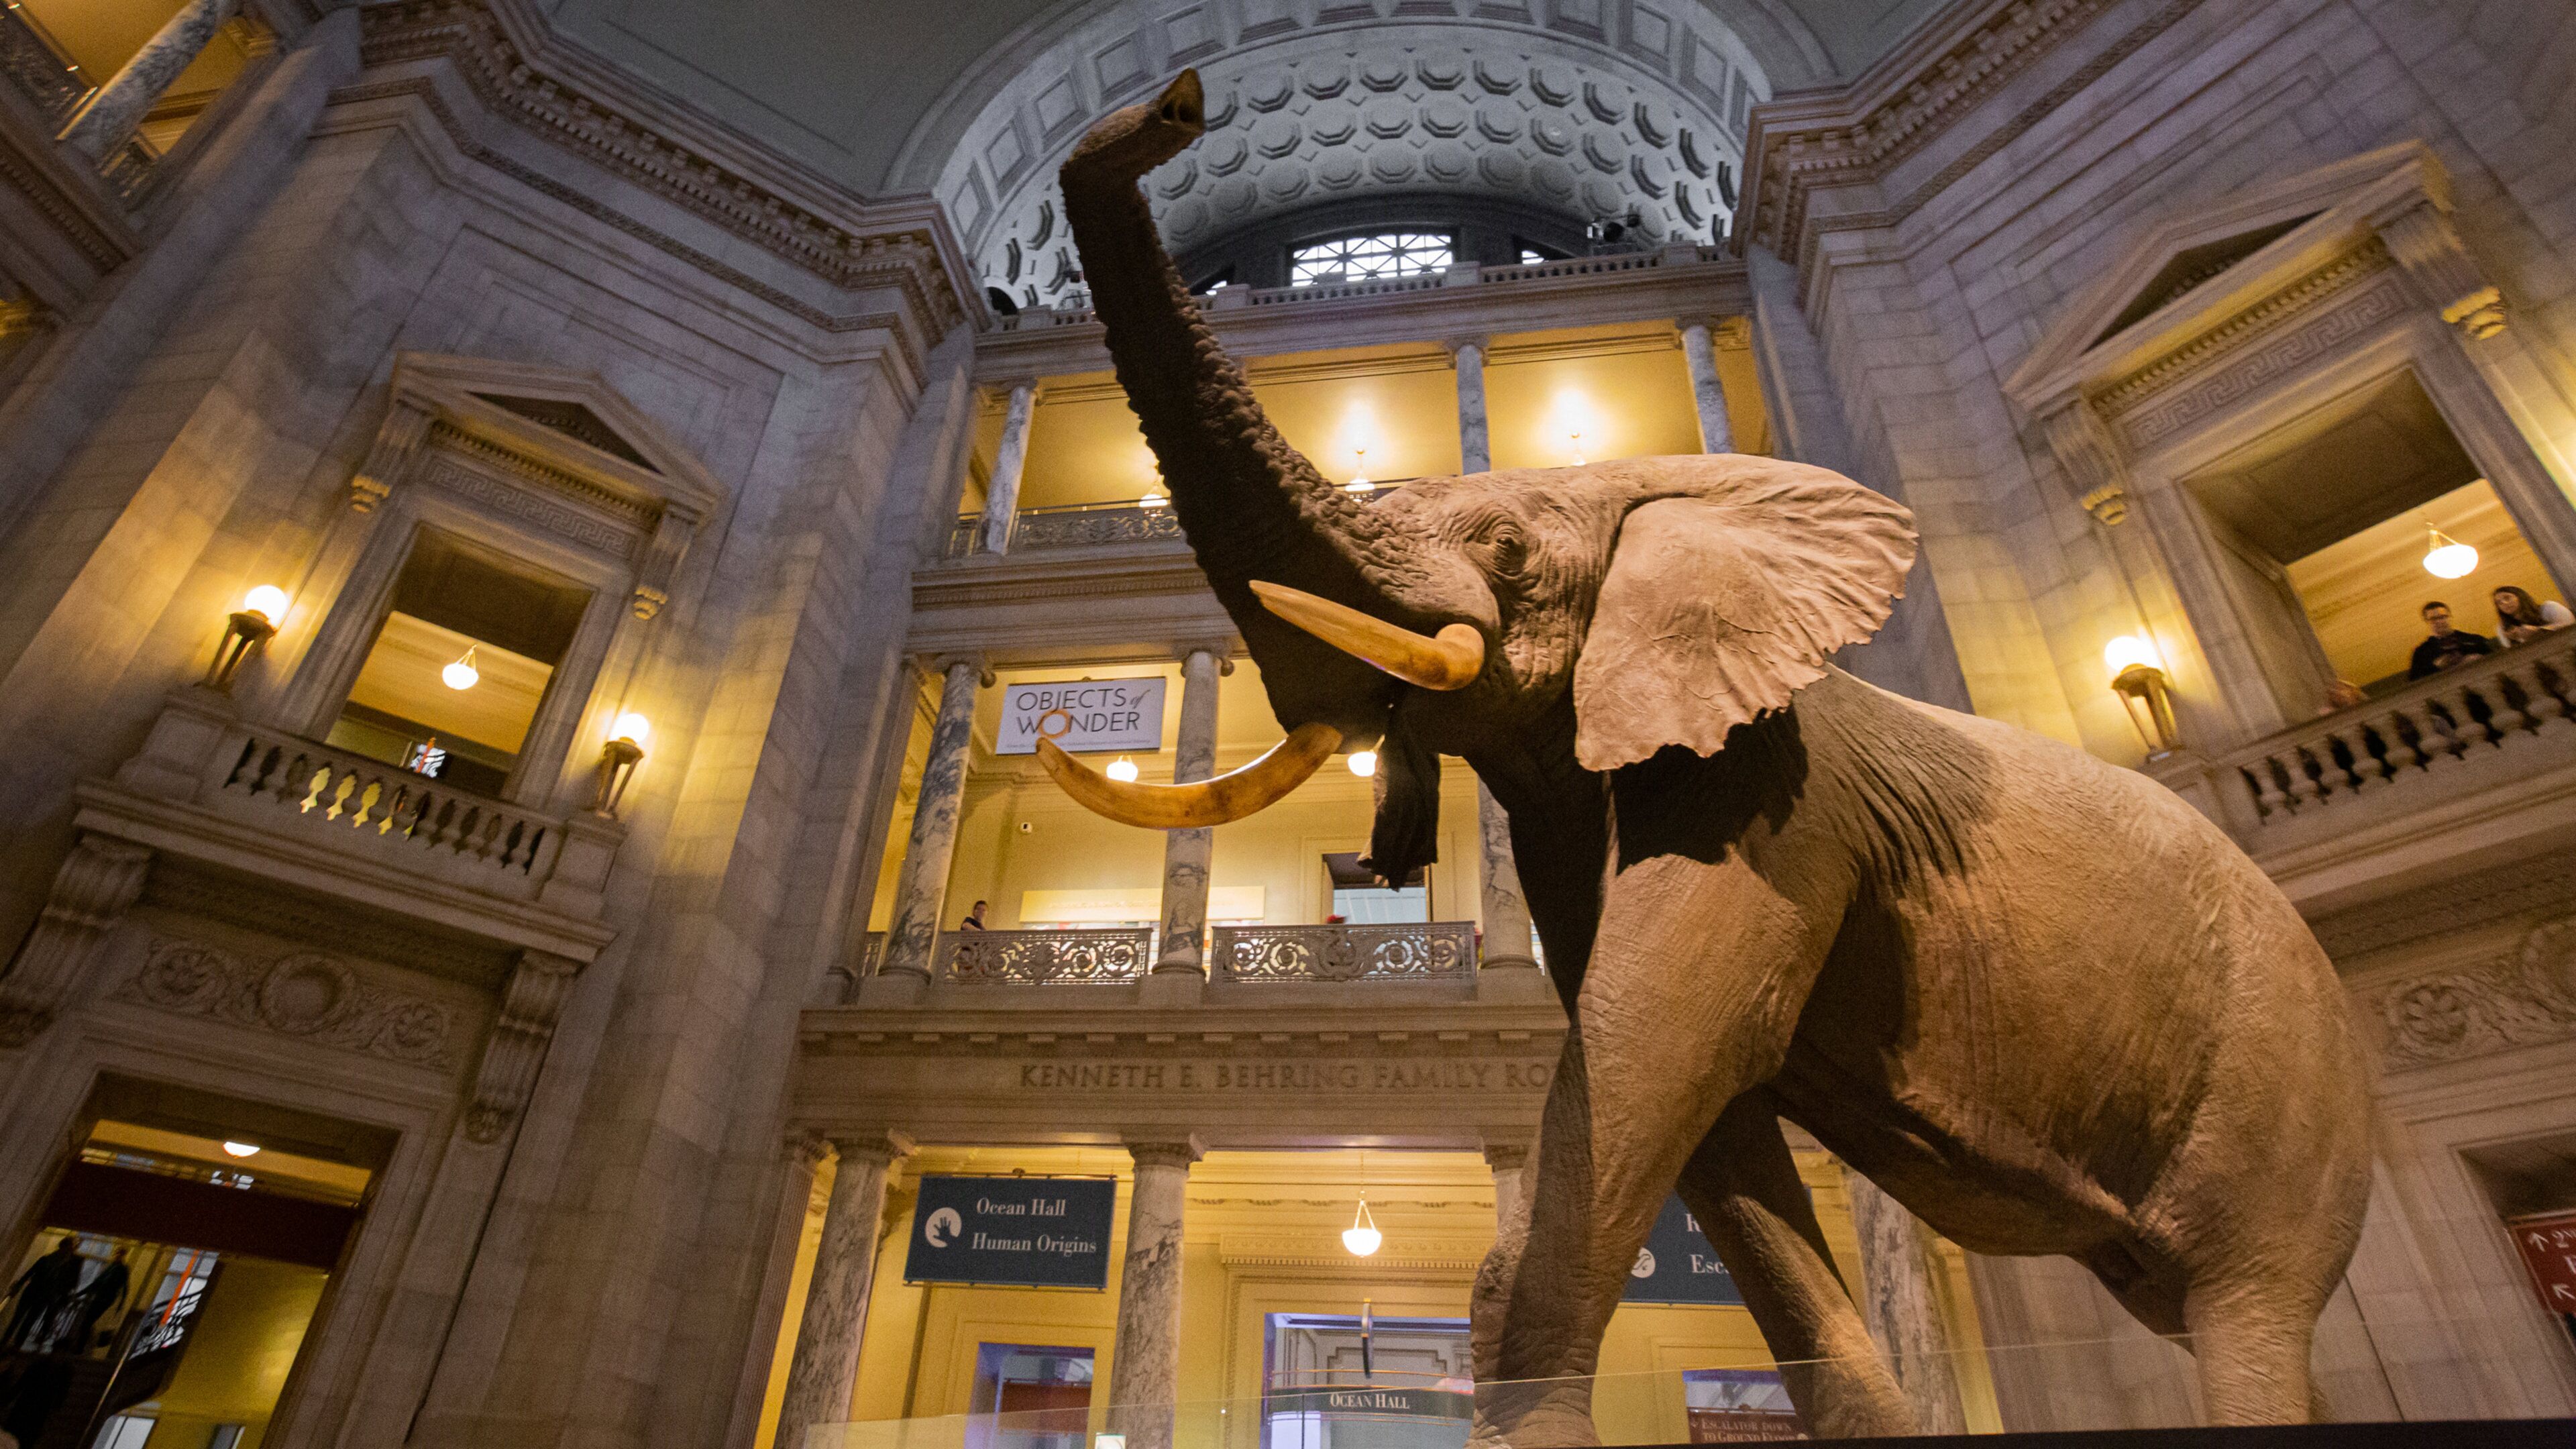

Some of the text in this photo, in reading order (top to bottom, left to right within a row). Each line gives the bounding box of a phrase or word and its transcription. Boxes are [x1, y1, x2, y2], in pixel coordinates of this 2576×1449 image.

[1016, 688, 1151, 712] OBJECTS of
[1016, 709, 1141, 739] WONDER
[1020, 1063, 1557, 1088] KENNETH E. BEHRING FAMILY RO
[977, 1197, 1067, 1216] Ocean Hall
[972, 1232, 1097, 1257] Human Origins
[1330, 1393, 1409, 1409] OCEAN HALL
